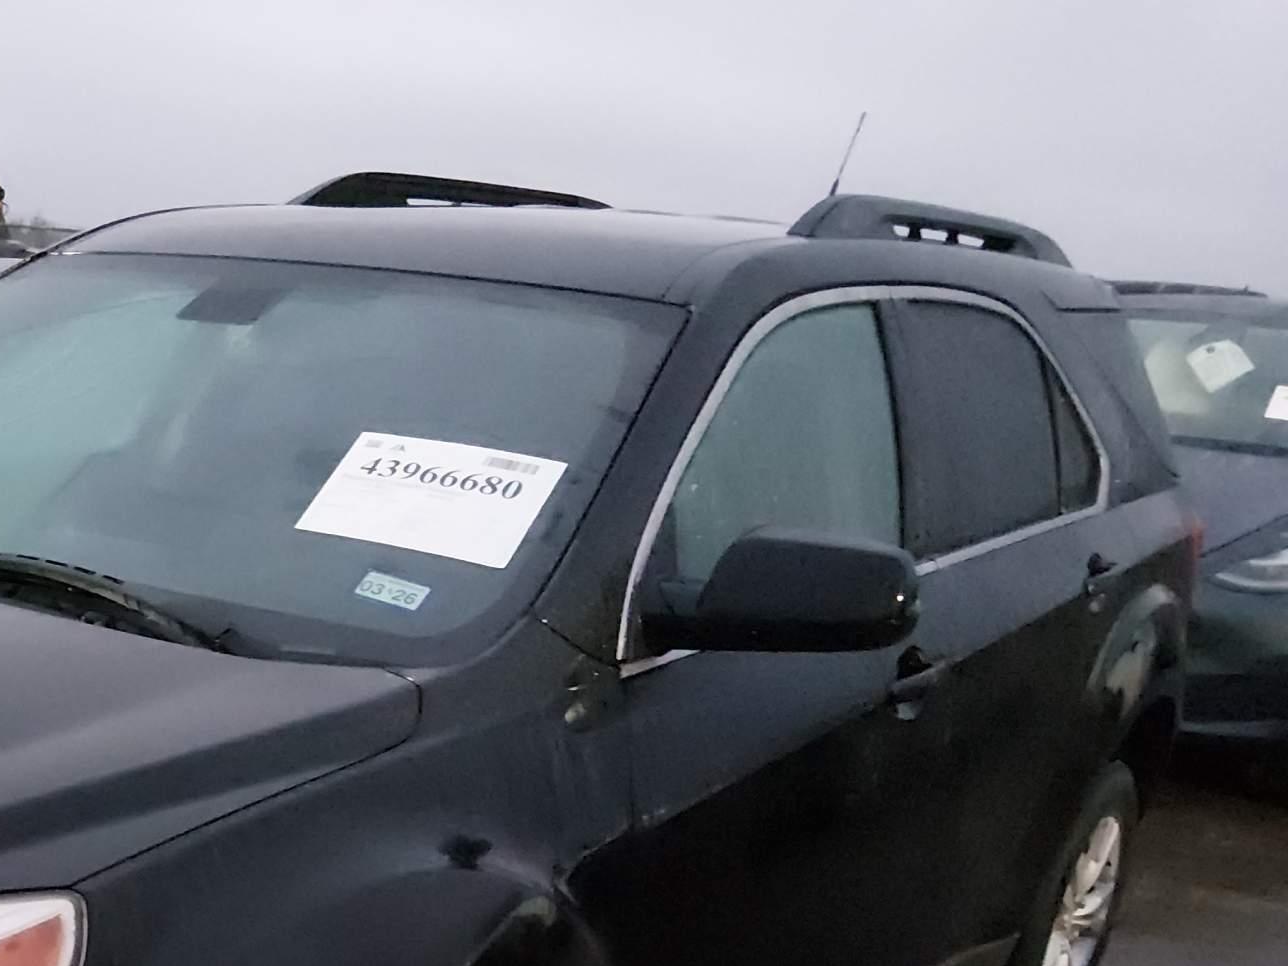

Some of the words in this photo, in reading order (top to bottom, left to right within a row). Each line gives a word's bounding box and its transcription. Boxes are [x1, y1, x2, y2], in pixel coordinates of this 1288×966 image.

[360, 457, 523, 500] 43966680
[359, 579, 385, 595] 03
[391, 589, 418, 605] 26
